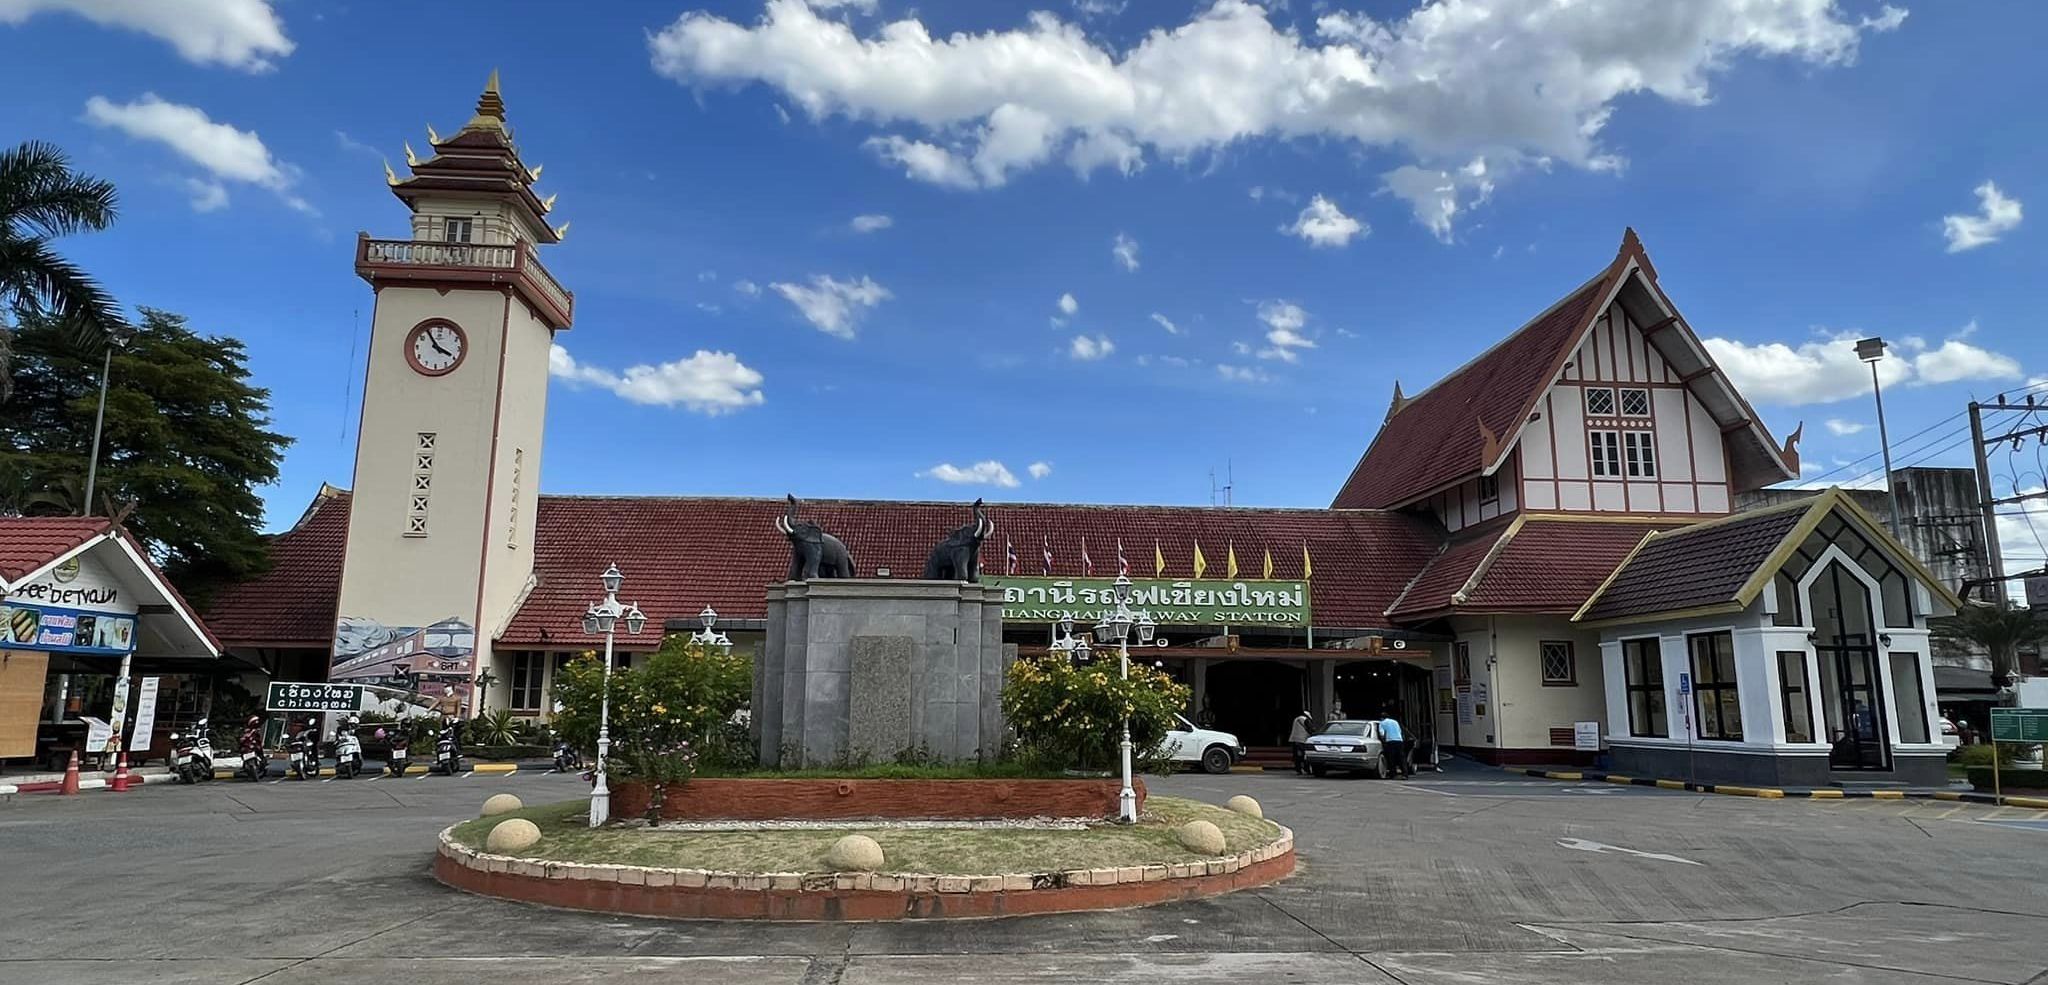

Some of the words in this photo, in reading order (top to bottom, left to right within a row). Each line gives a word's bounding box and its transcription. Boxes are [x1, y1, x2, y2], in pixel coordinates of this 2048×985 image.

[1003, 581, 1303, 607] ถานีรถฟเชียงใหม่
[1214, 611, 1301, 622] STATION
